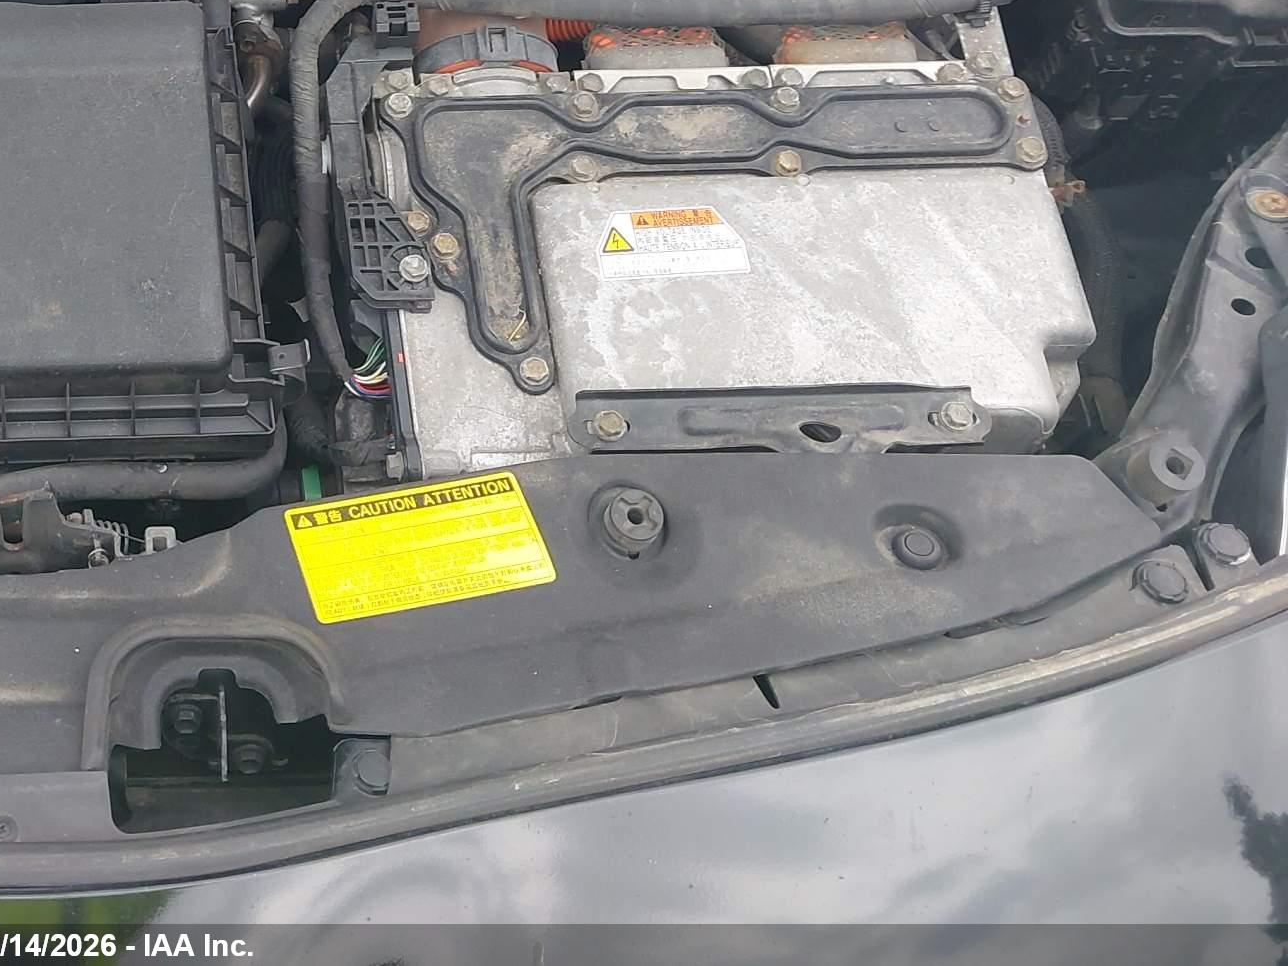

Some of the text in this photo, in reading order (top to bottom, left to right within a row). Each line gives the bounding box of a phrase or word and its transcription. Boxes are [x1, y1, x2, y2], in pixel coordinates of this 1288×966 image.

[652, 209, 686, 219] WARNING
[652, 217, 713, 227] AVERTISSEMENT
[348, 496, 417, 520] CAUTION
[422, 478, 512, 508] ATTENTION
